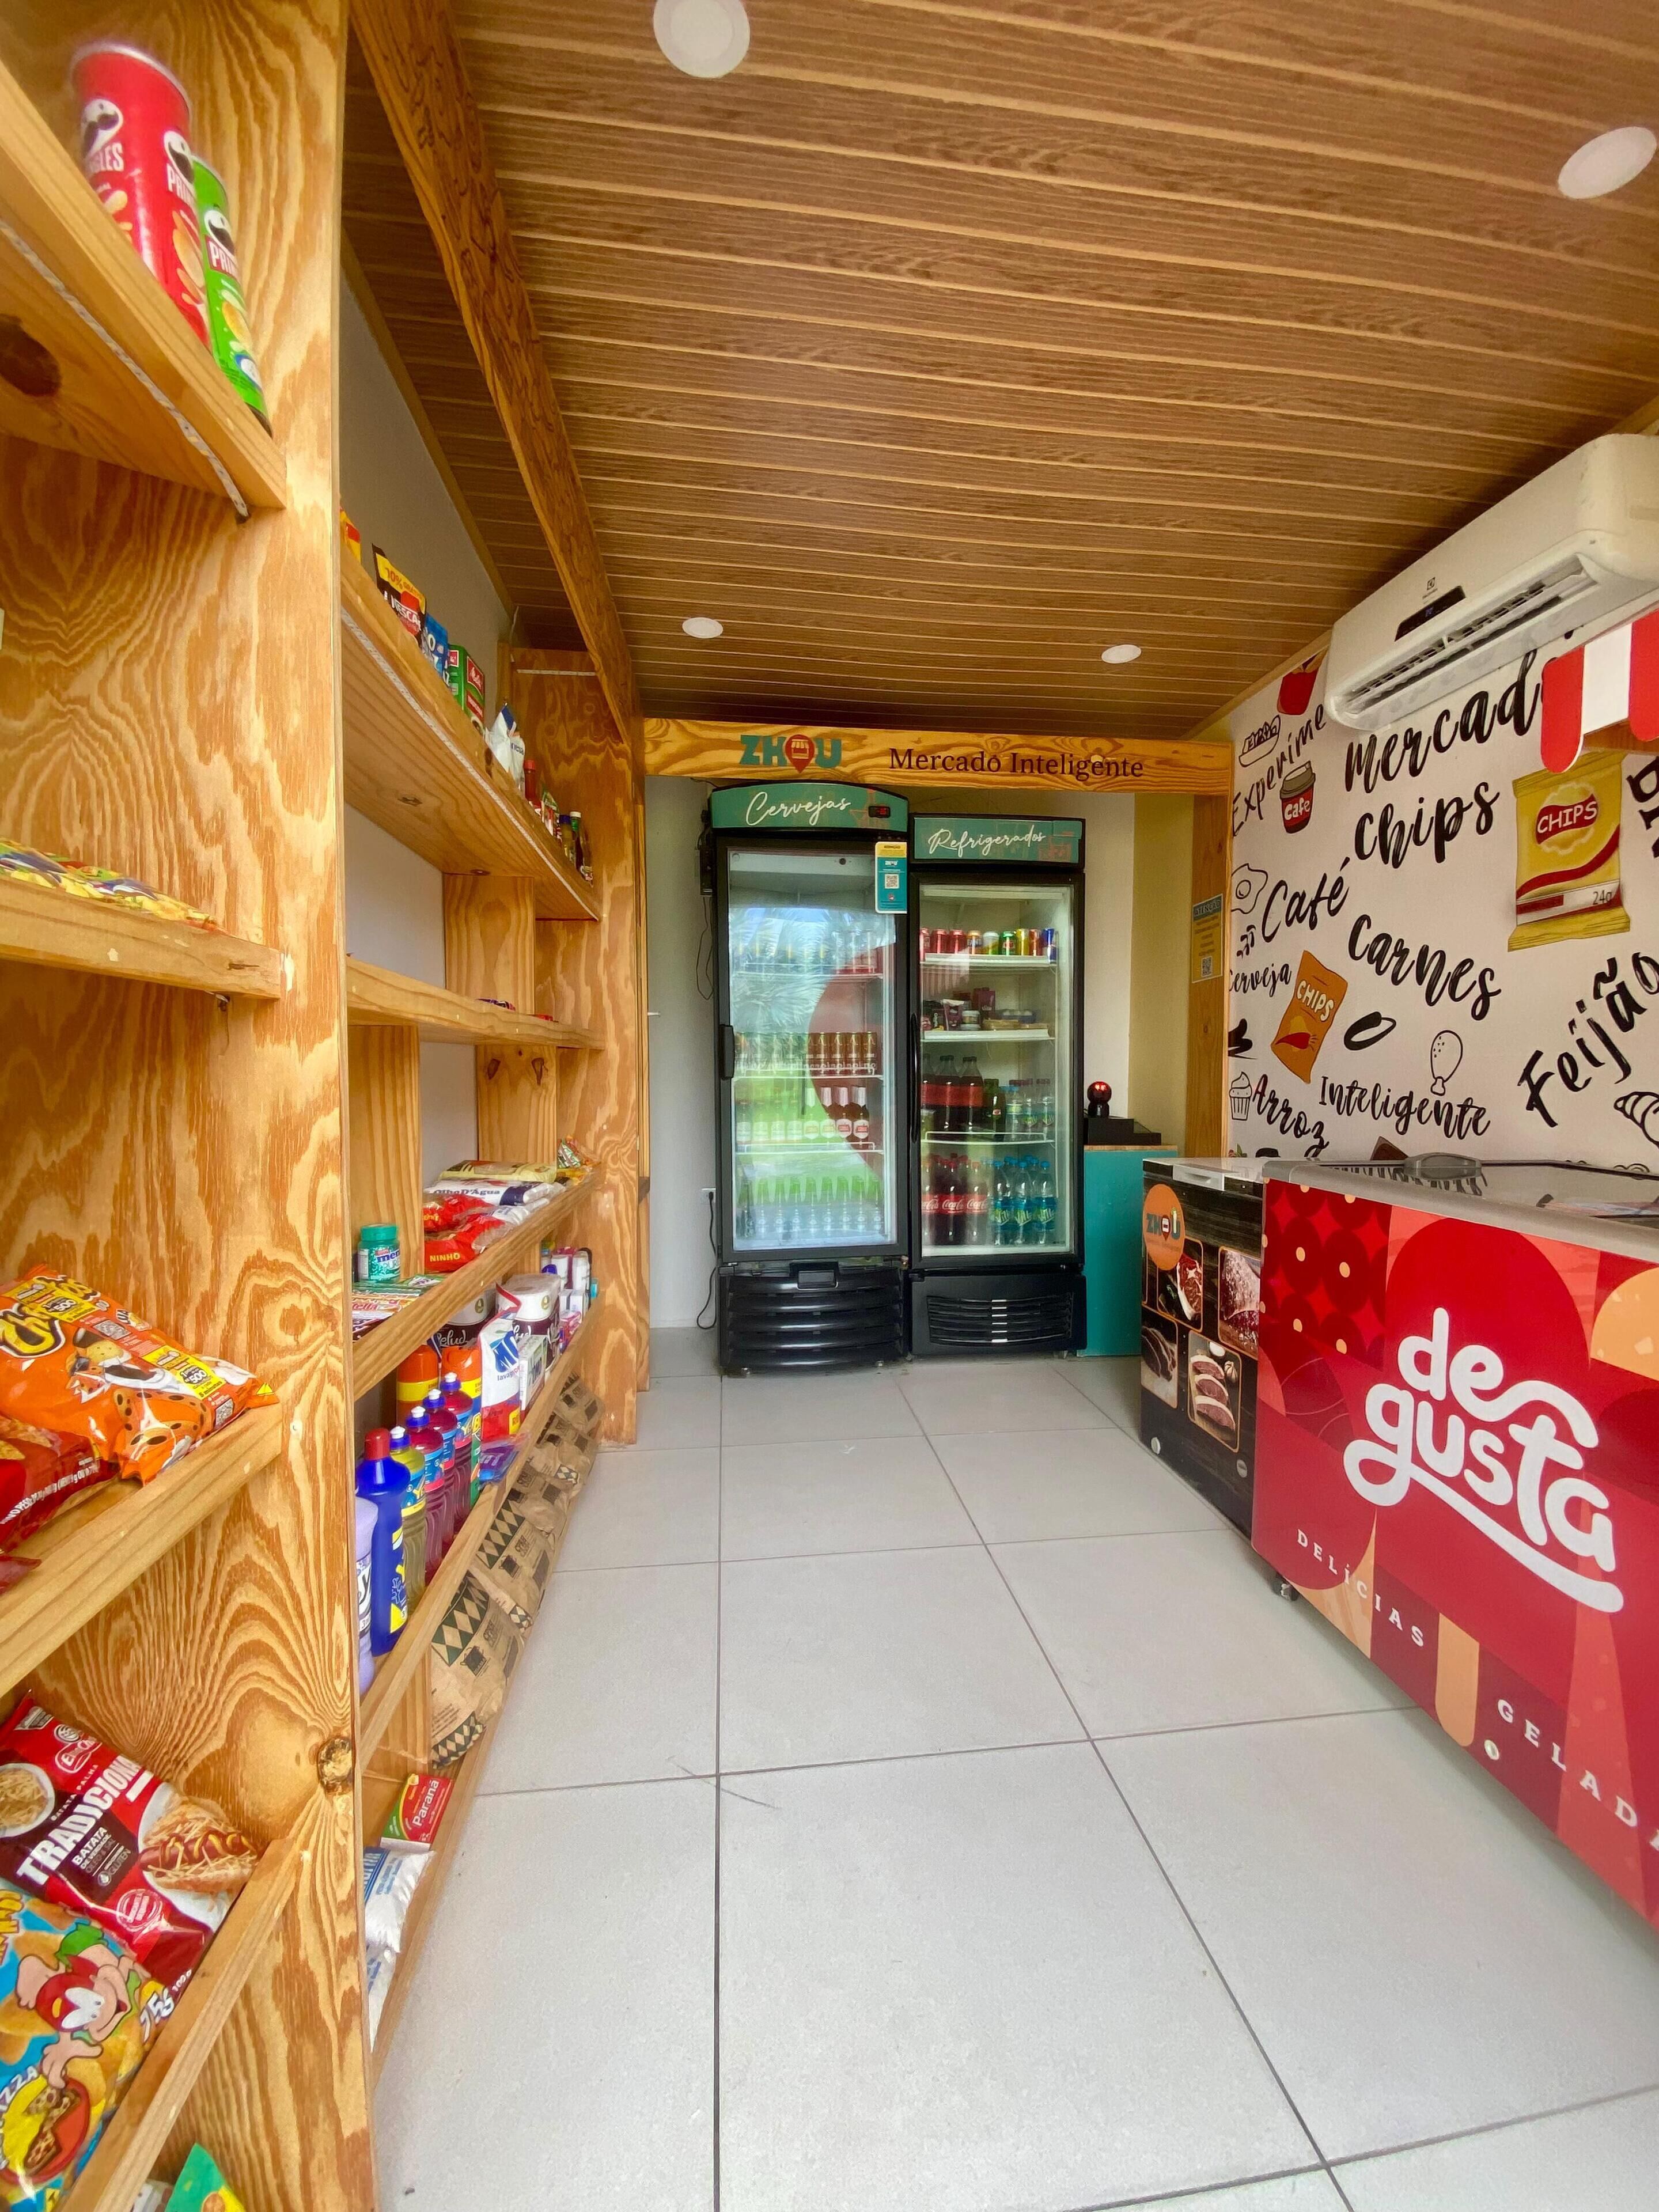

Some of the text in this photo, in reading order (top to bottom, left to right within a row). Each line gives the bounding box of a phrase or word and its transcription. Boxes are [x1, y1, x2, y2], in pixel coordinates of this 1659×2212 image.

[889, 748, 1143, 782] Mercado Inteligente
[746, 791, 851, 825] Cervejas
[1537, 801, 1597, 833] CHIPS
[929, 824, 1046, 857] Refrigerados
[1262, 857, 1350, 943] Café
[1229, 963, 1291, 997] erveja
[1296, 980, 1335, 1022] CHIPS
[1517, 952, 1659, 1128] Feijão
[1252, 1074, 1330, 1158] Arroz
[1319, 1075, 1491, 1140] Inteligente
[430, 1252, 460, 1262] NINHO
[1297, 1528, 1425, 1647] DELÍCIAS
[412, 1779, 440, 1827] Paraná
[72, 1827, 108, 1866] BATATA
